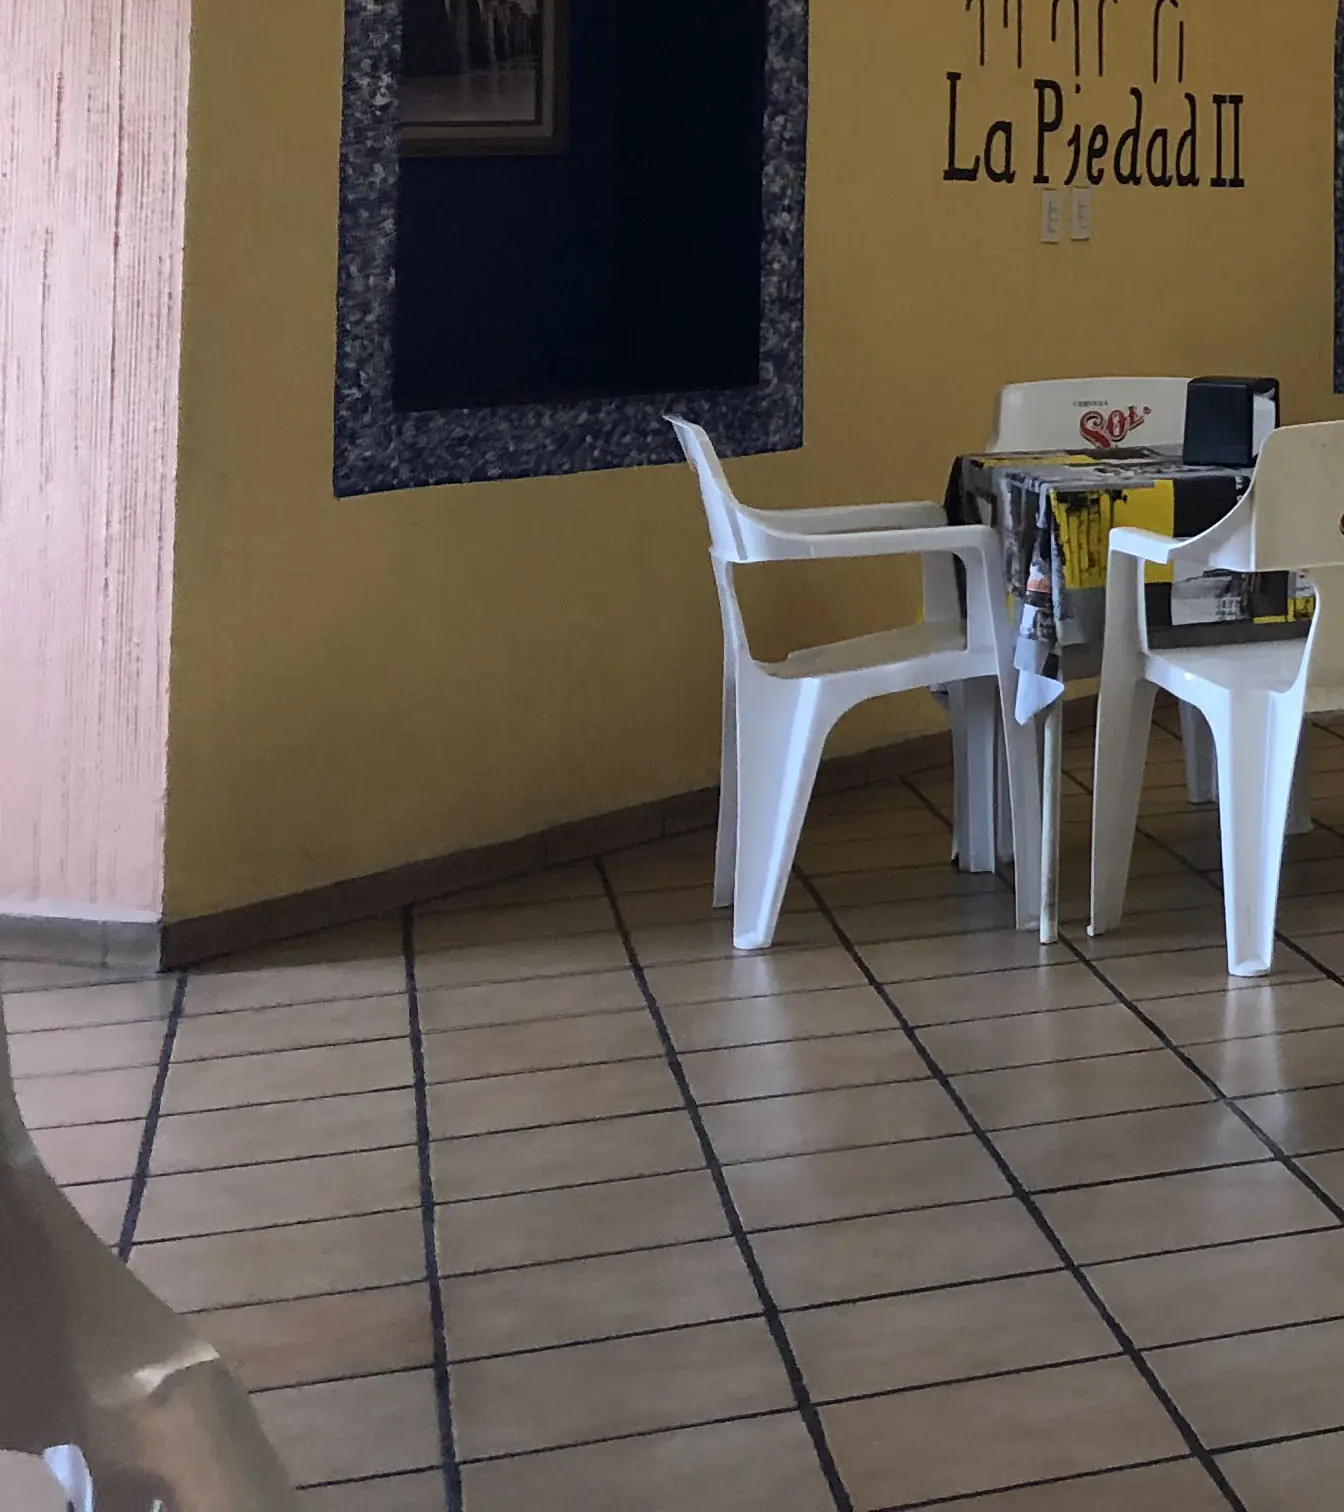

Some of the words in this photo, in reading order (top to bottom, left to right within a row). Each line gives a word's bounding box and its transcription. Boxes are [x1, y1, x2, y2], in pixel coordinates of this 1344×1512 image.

[942, 71, 1016, 183] La
[1033, 78, 1200, 187] Piedad
[1209, 94, 1245, 188] II
